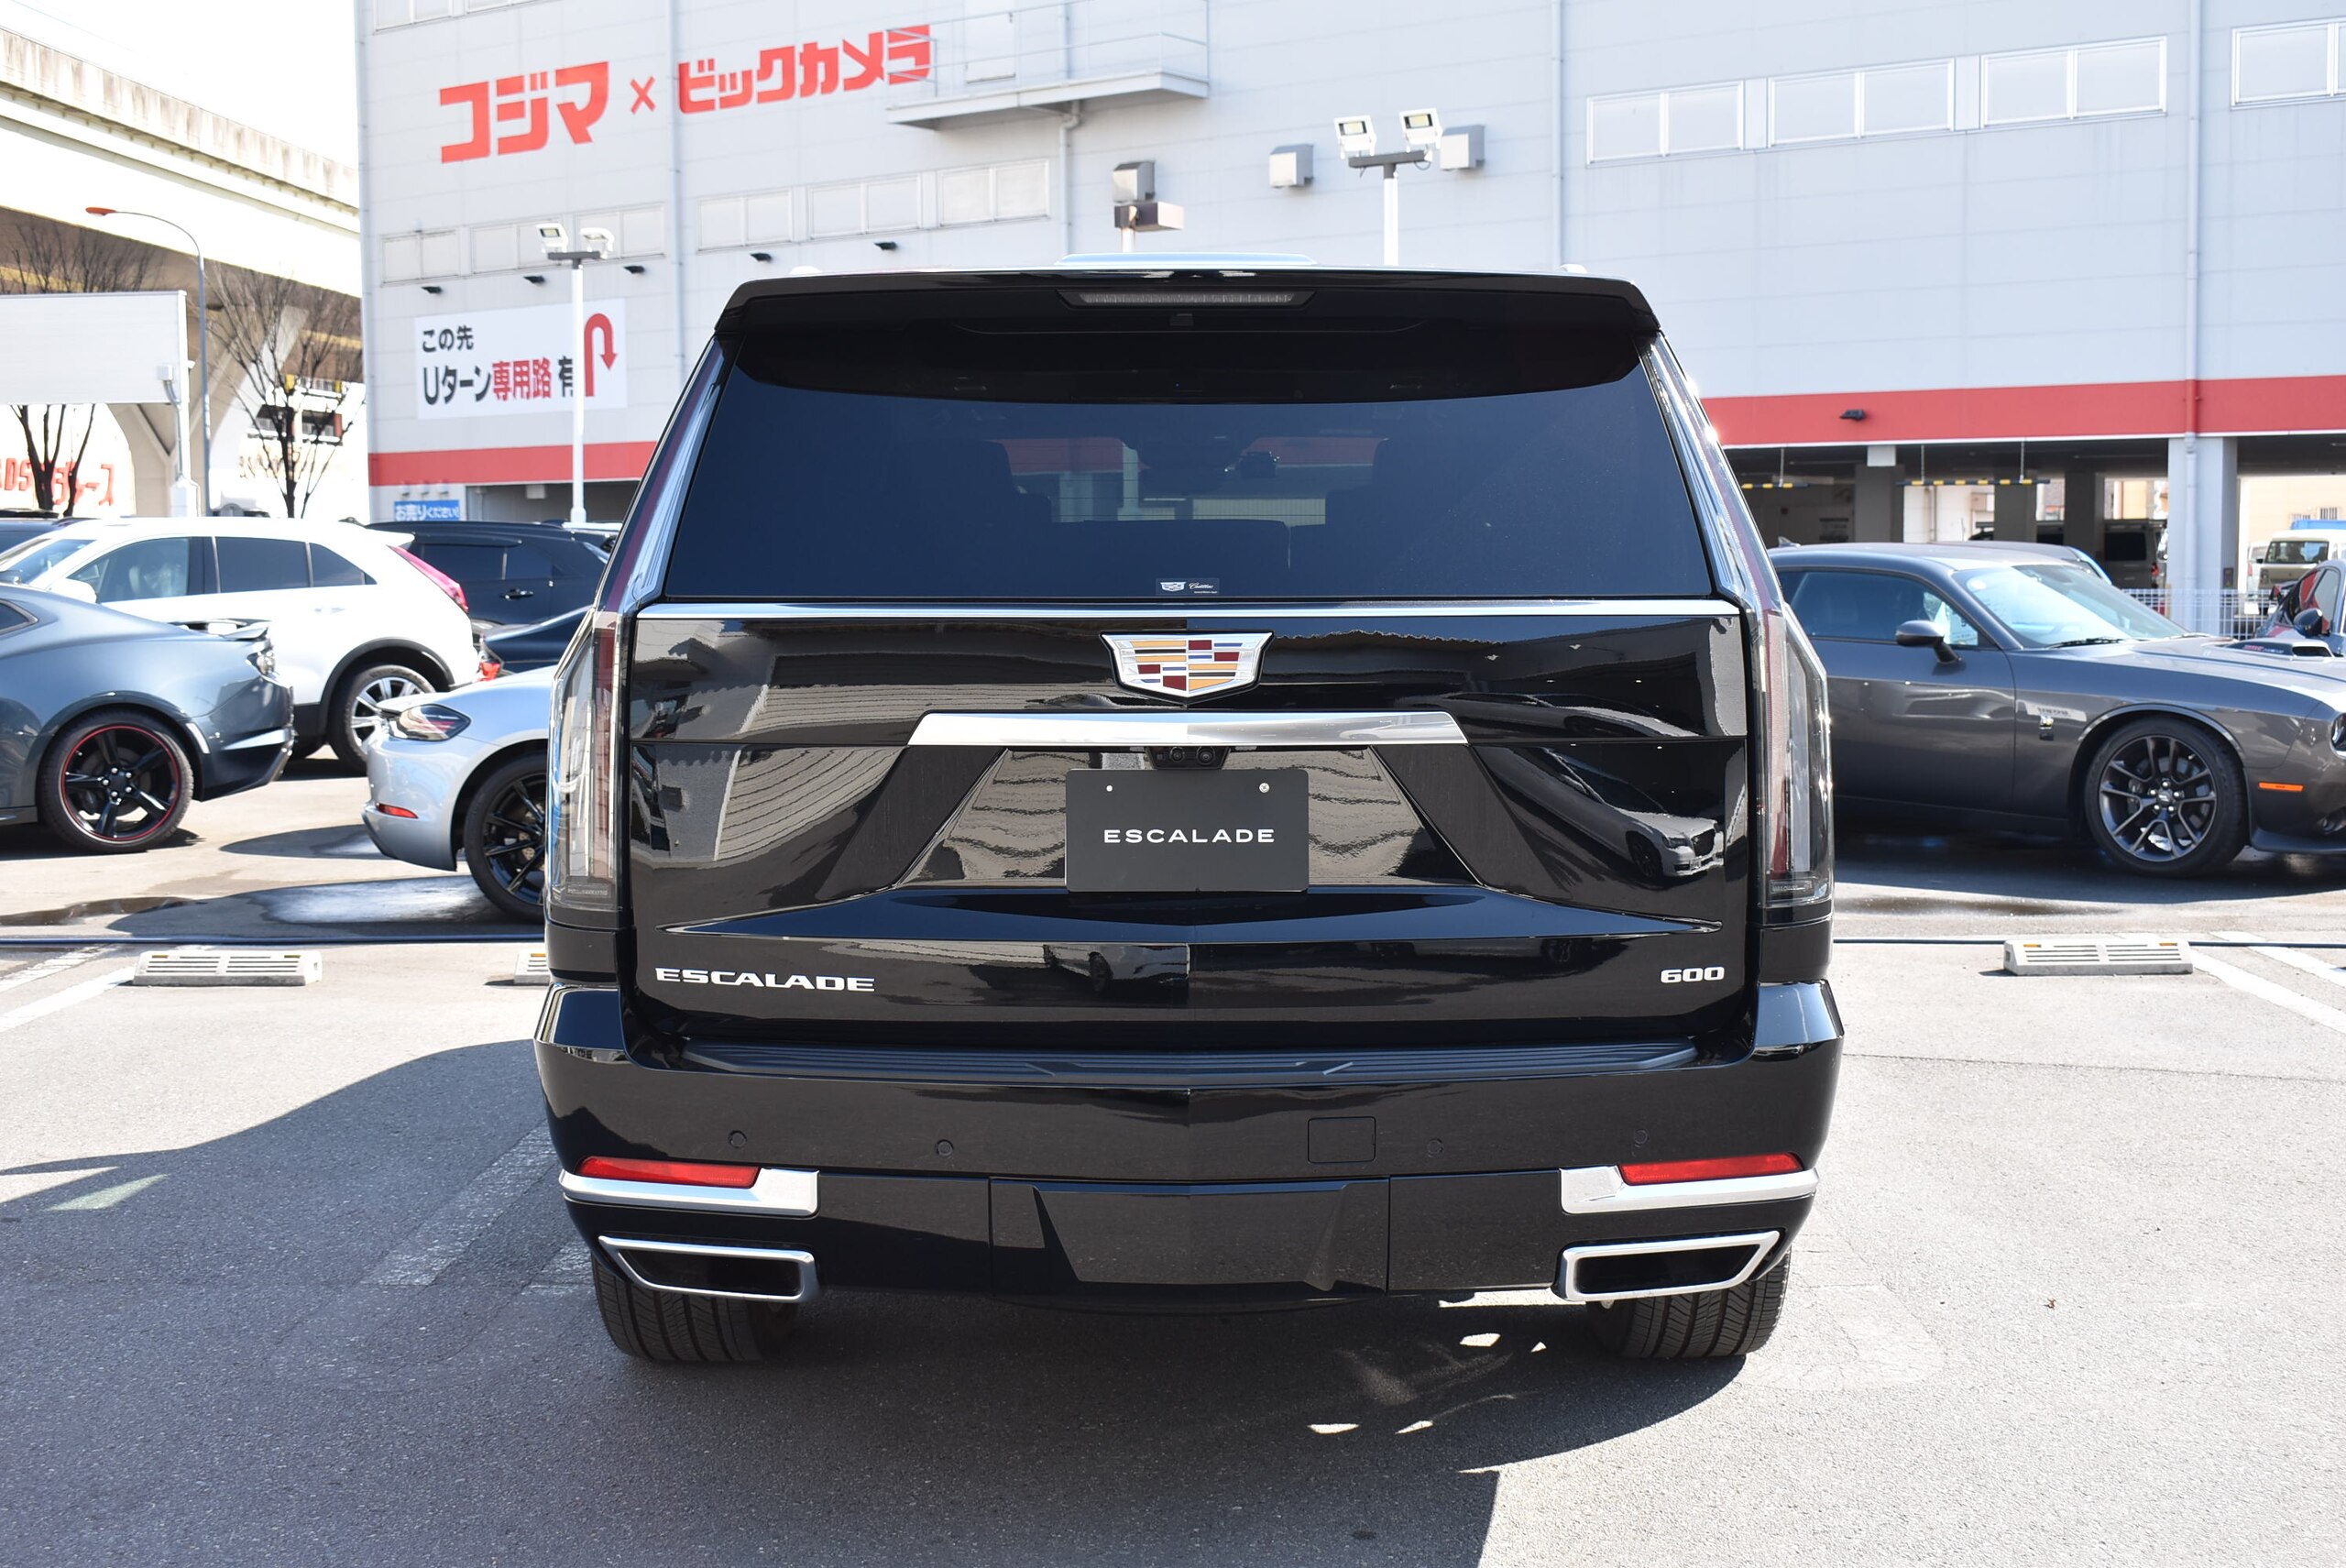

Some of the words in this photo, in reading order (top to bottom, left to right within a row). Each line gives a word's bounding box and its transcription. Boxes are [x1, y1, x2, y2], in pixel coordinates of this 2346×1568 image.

[440, 61, 609, 163] コジマ
[677, 24, 931, 115] ビックカメラ
[422, 325, 474, 353] この先
[1103, 828, 1275, 844] ESCALADE
[654, 967, 875, 992] ESCALADE
[1661, 966, 1725, 983] 600
